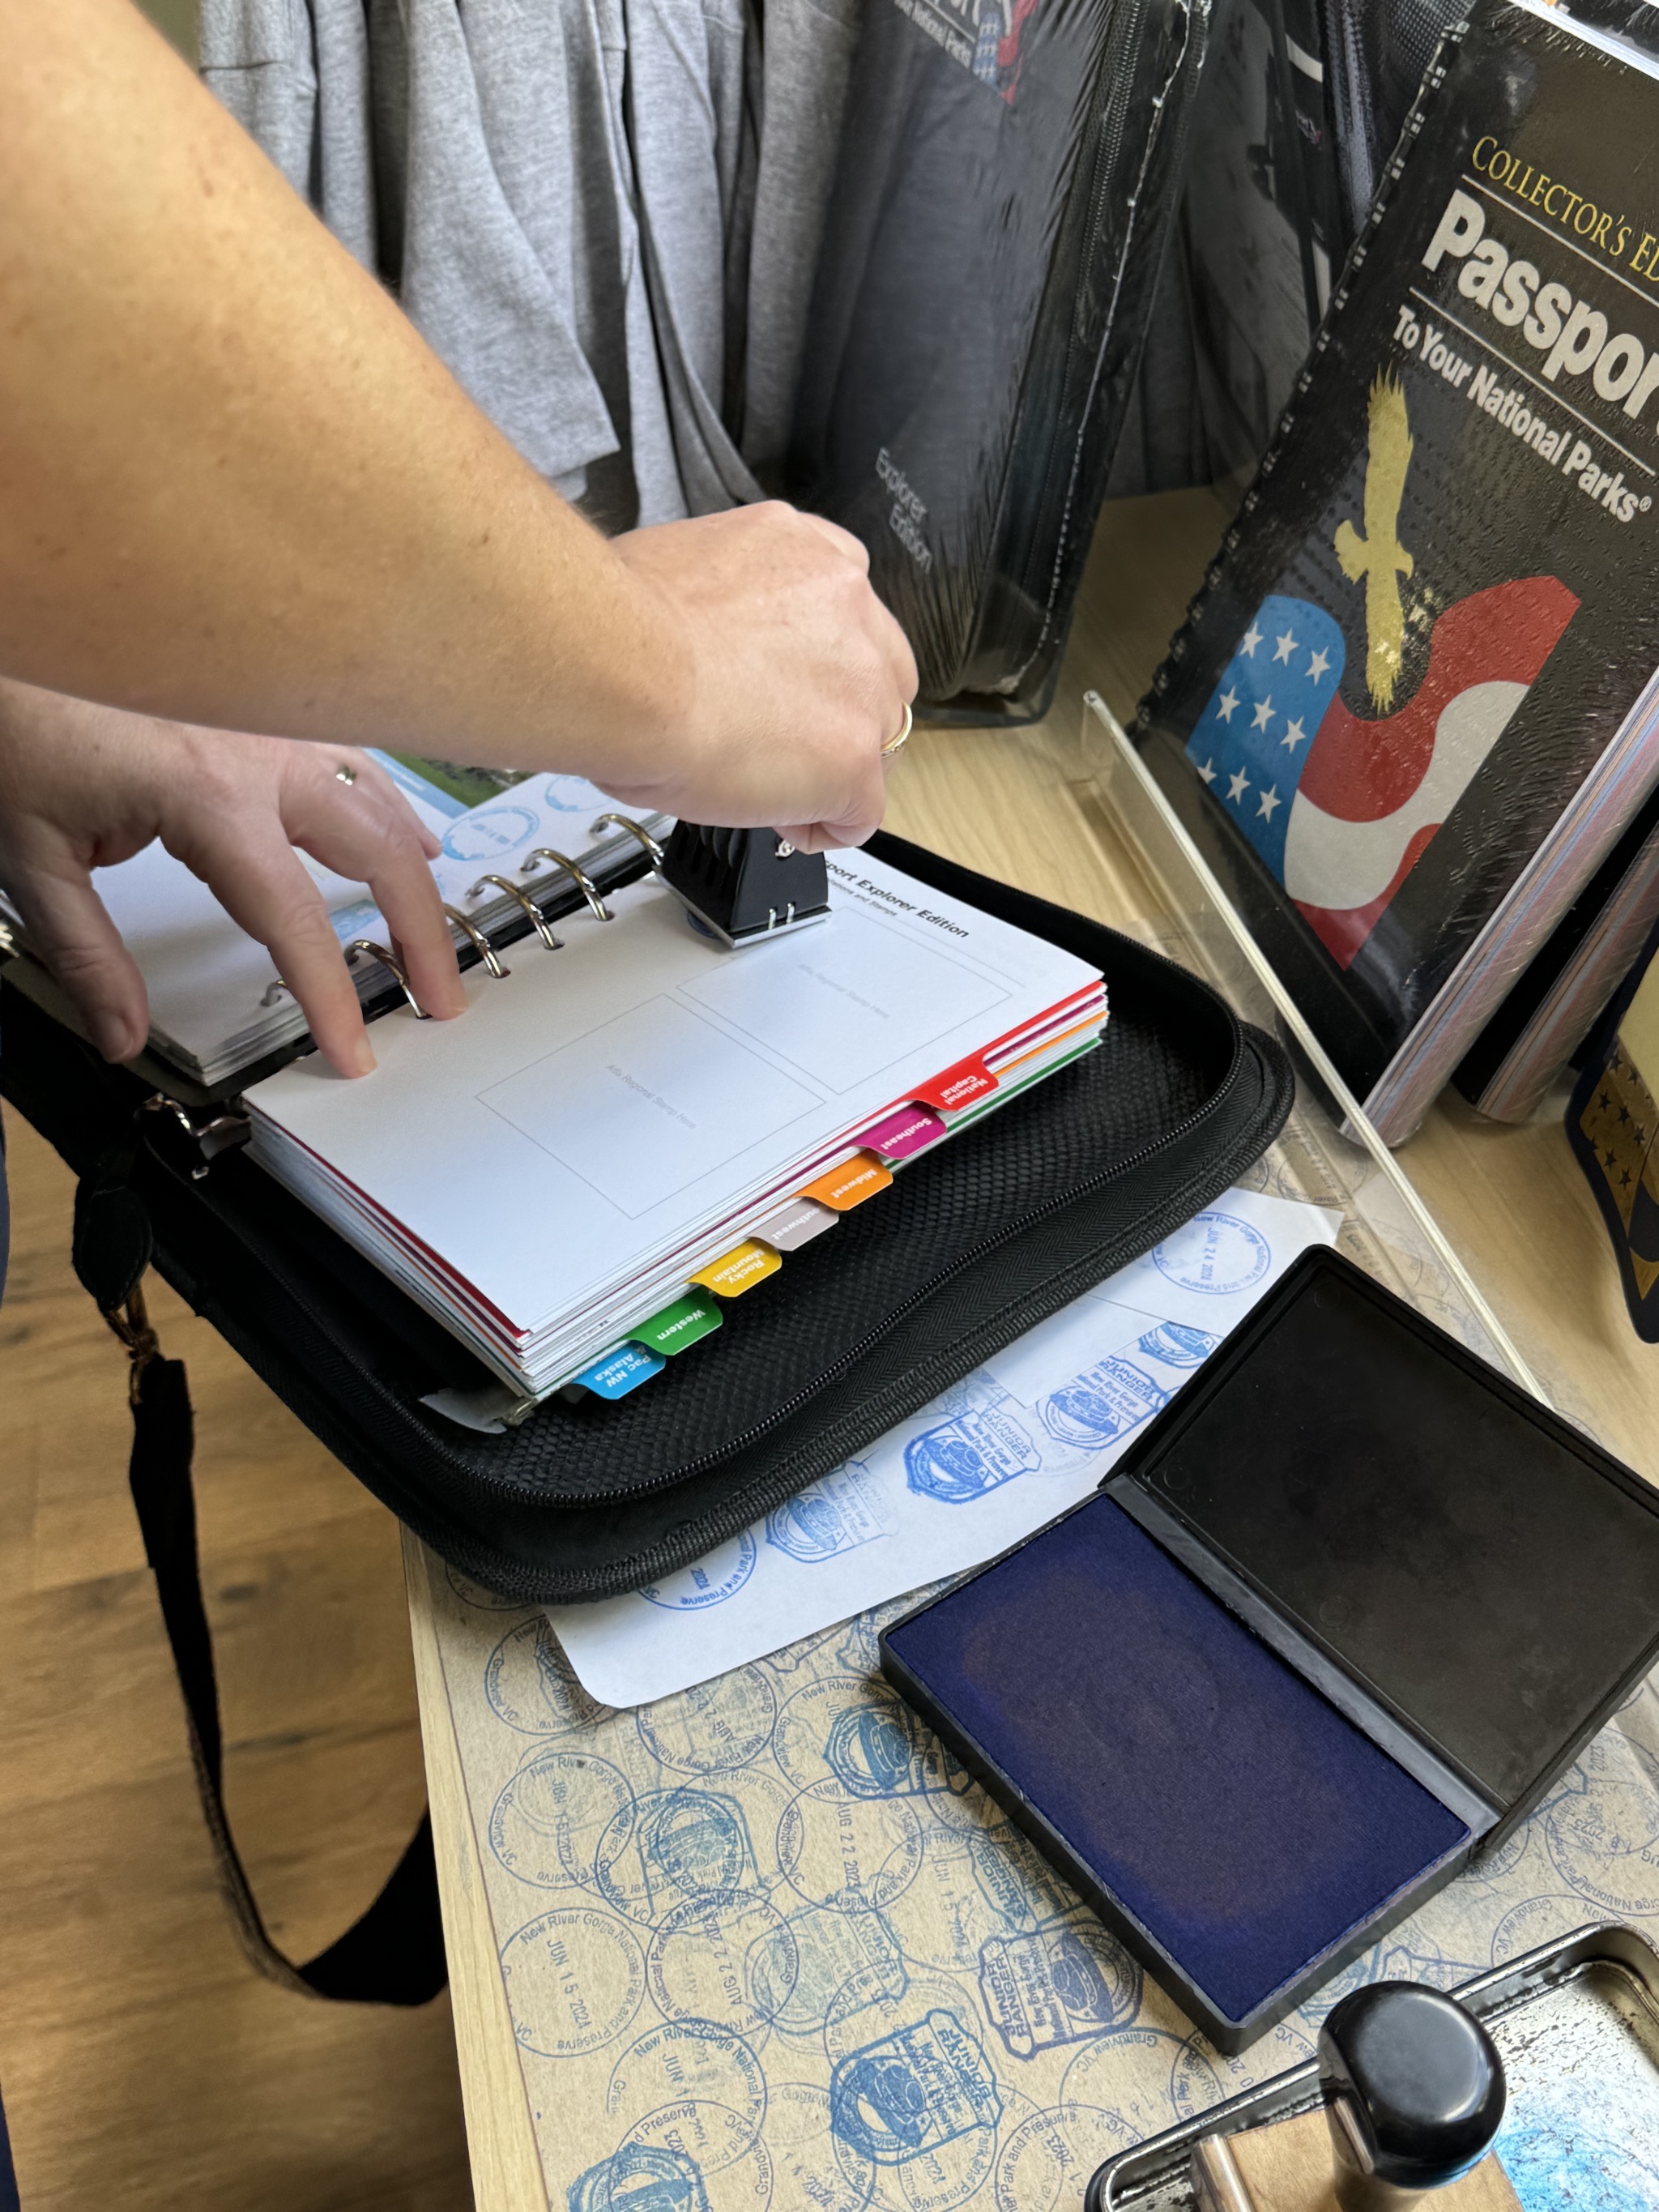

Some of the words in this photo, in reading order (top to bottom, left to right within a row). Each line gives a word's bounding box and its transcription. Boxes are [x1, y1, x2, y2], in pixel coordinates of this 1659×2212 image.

[1472, 136, 1632, 256] COLLECTOR'S
[1422, 189, 1659, 438] Passpor
[1393, 304, 1419, 349] To
[1419, 324, 1473, 388] Your
[1466, 365, 1572, 466] National
[876, 447, 928, 523] Explorer
[889, 503, 932, 574] Edition
[857, 879, 918, 912] Explorer
[917, 909, 970, 938] Edition
[940, 1075, 978, 1098] Capital
[944, 1078, 988, 1105] National
[881, 1117, 932, 1151] Southeast
[830, 1168, 877, 1199] Midwest
[771, 1207, 821, 1241] outhwest
[1215, 1215, 1239, 1228] River
[1207, 1227, 1218, 1243] JUN
[713, 1249, 765, 1283] Mountain
[727, 1259, 766, 1285] Rocky
[1179, 1276, 1222, 1292] Preserve
[656, 1309, 706, 1341] Western
[594, 1353, 634, 1382] Alaska
[627, 1354, 651, 1372] Pac
[605, 1369, 629, 1389] NW
[1098, 1360, 1154, 1401] RANGER
[1102, 1379, 1120, 1397] River
[1107, 1360, 1158, 1396] JUNIOR
[1095, 1385, 1111, 1402] Park
[981, 1433, 996, 1450] River
[983, 1413, 1027, 1460] RANGER
[991, 1412, 1031, 1454] JUNIOR
[971, 1439, 986, 1454] Park
[739, 1553, 753, 1574] Park
[724, 1574, 742, 1591] and
[680, 1587, 729, 1605] Preserve
[489, 1658, 505, 1707] Grandview
[502, 1706, 519, 1722] VC
[801, 1685, 825, 1702] New
[827, 1680, 857, 1691] River
[825, 1702, 842, 1720] JU
[712, 1719, 736, 1743] AUG
[775, 1715, 793, 1769] Grandview
[790, 1769, 806, 1786] VC
[529, 1761, 555, 1779] New
[588, 1760, 617, 1786] Gorge
[729, 1770, 760, 1786] River
[493, 1792, 514, 1848] Grandview
[837, 1803, 853, 1827] AUG
[935, 1832, 965, 1845] River
[502, 1847, 518, 1865] VC
[932, 1855, 950, 1882] JUN
[536, 1867, 589, 1883] Preserve
[788, 1865, 805, 1885] VC
[1580, 1878, 1632, 1911] National
[547, 1914, 580, 1929] River
[582, 1912, 616, 1935] Gorge
[633, 1905, 649, 1922] VC
[758, 1906, 776, 1924] VC
[1501, 1898, 1553, 1935] Grandview
[519, 1921, 546, 1945] New
[1495, 1937, 1512, 1955] VC
[546, 1939, 569, 1967] JUN
[613, 1929, 640, 1976] National
[622, 1978, 642, 2007] Park
[723, 1975, 743, 2006] AUG
[987, 1961, 1017, 2036] JUNIOR
[997, 1955, 1028, 2037] RANGER
[609, 2005, 629, 2030] and
[515, 2022, 533, 2042] VC
[557, 2026, 612, 2050] Preserve
[1093, 2032, 1158, 2056] Grandview
[1274, 2026, 1294, 2046] VC
[633, 2035, 661, 2058] New
[663, 2026, 696, 2043] River
[732, 2046, 762, 2096] National
[662, 2053, 686, 2082] JUN
[937, 2028, 984, 2108] RANGER
[949, 2029, 992, 2099] JUNIOR
[1076, 2054, 1096, 2073] VC
[642, 2102, 697, 2136] Preserve
[663, 2129, 689, 2162] 2023
[1000, 2163, 1015, 2194] Park
[1008, 2136, 1027, 2163] and
